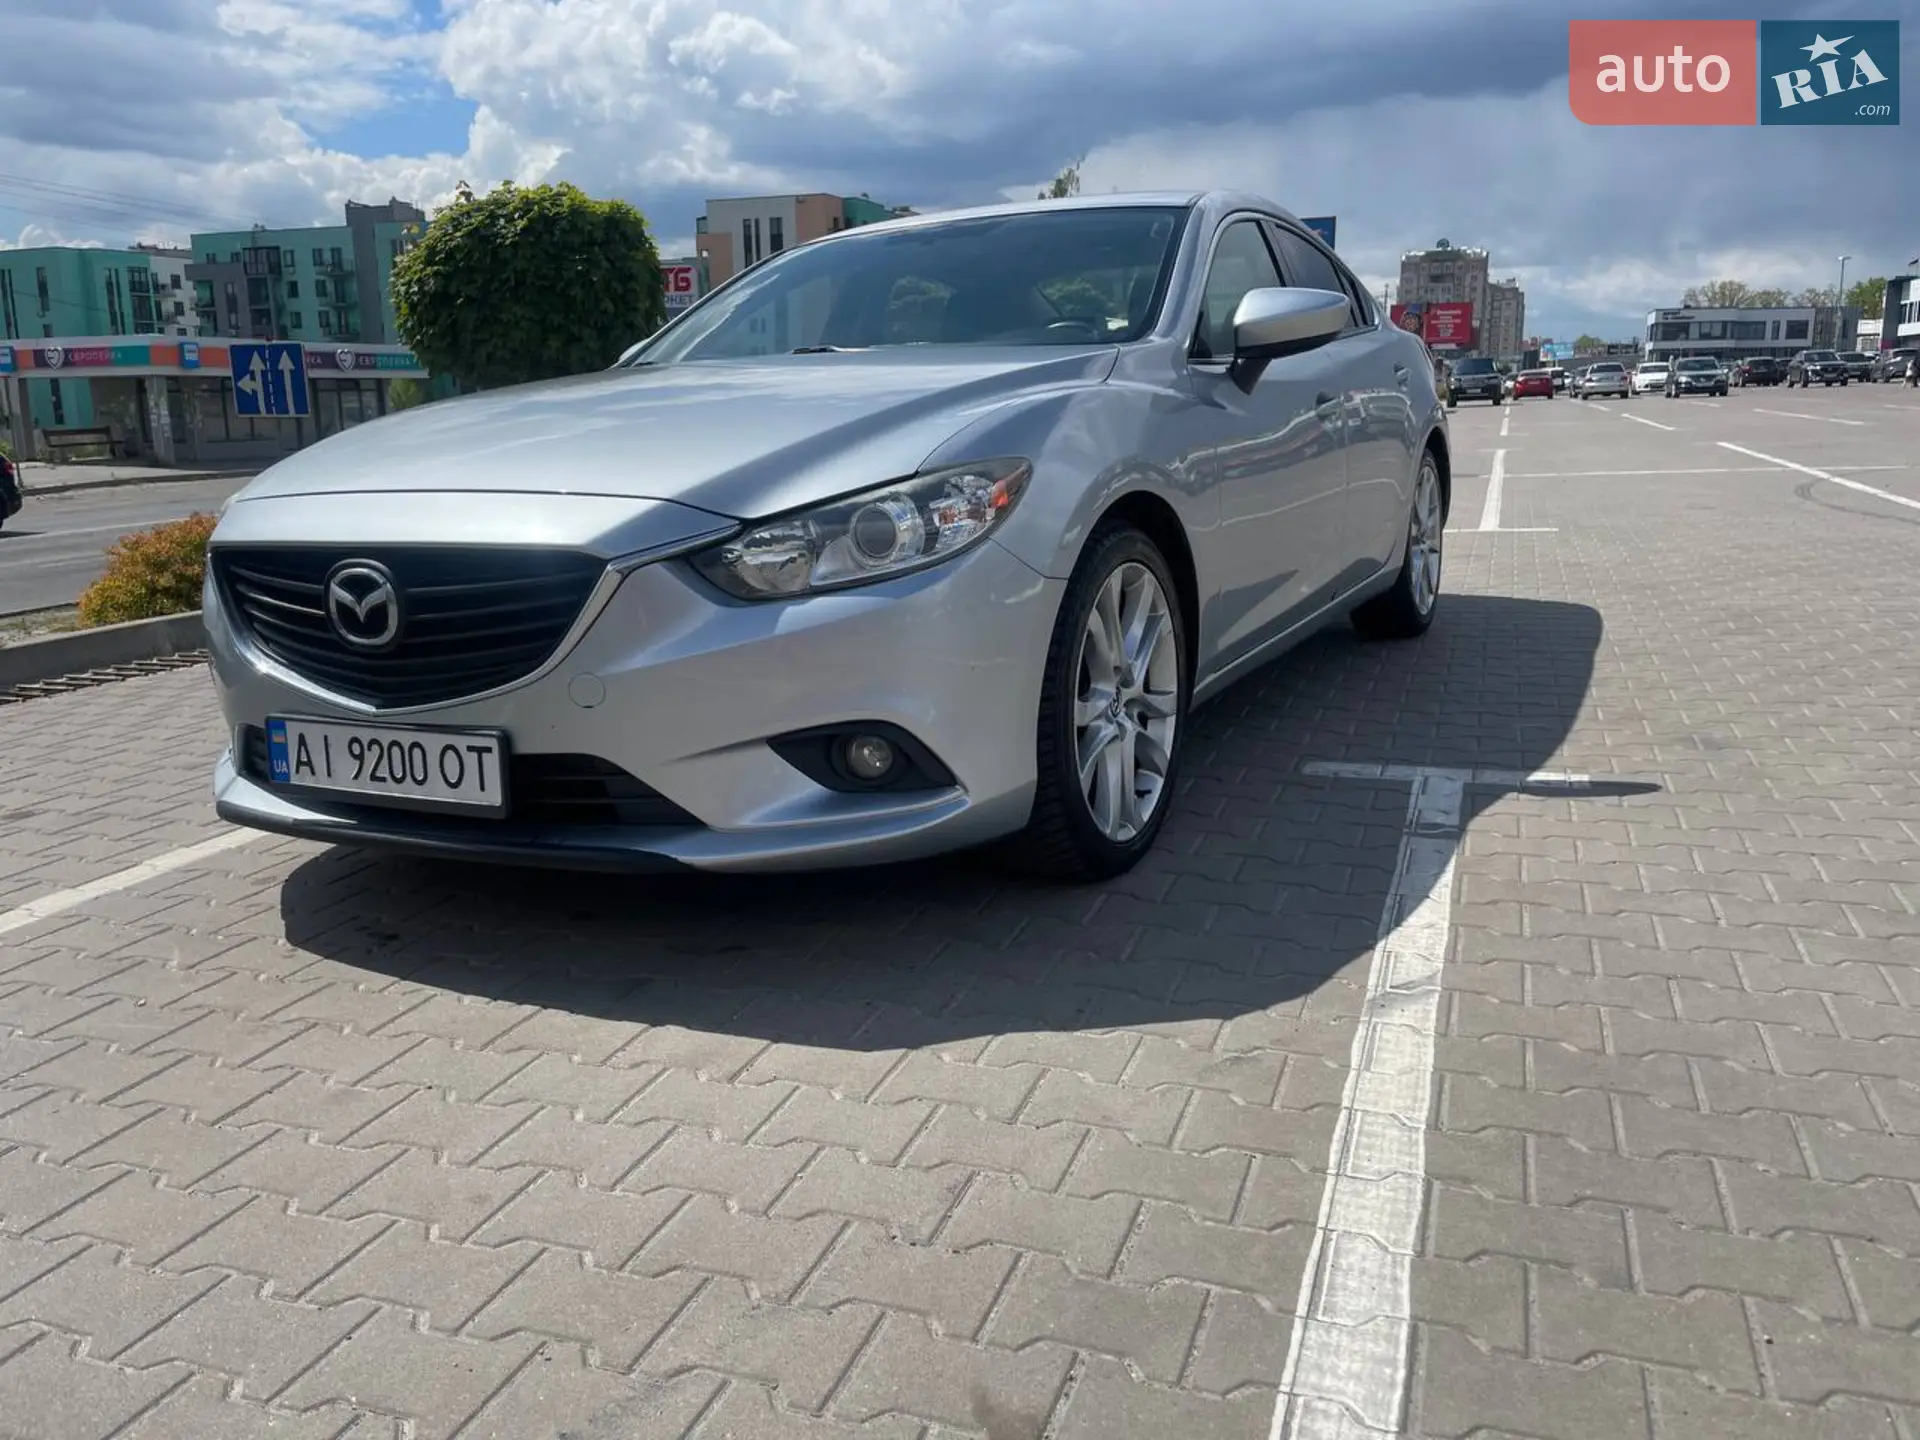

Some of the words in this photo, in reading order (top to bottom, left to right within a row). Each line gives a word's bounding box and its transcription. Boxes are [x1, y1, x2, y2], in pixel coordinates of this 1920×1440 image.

[274, 760, 289, 773] UA
[295, 732, 332, 778] AI
[348, 736, 428, 786] 9200
[439, 743, 493, 792] OT
